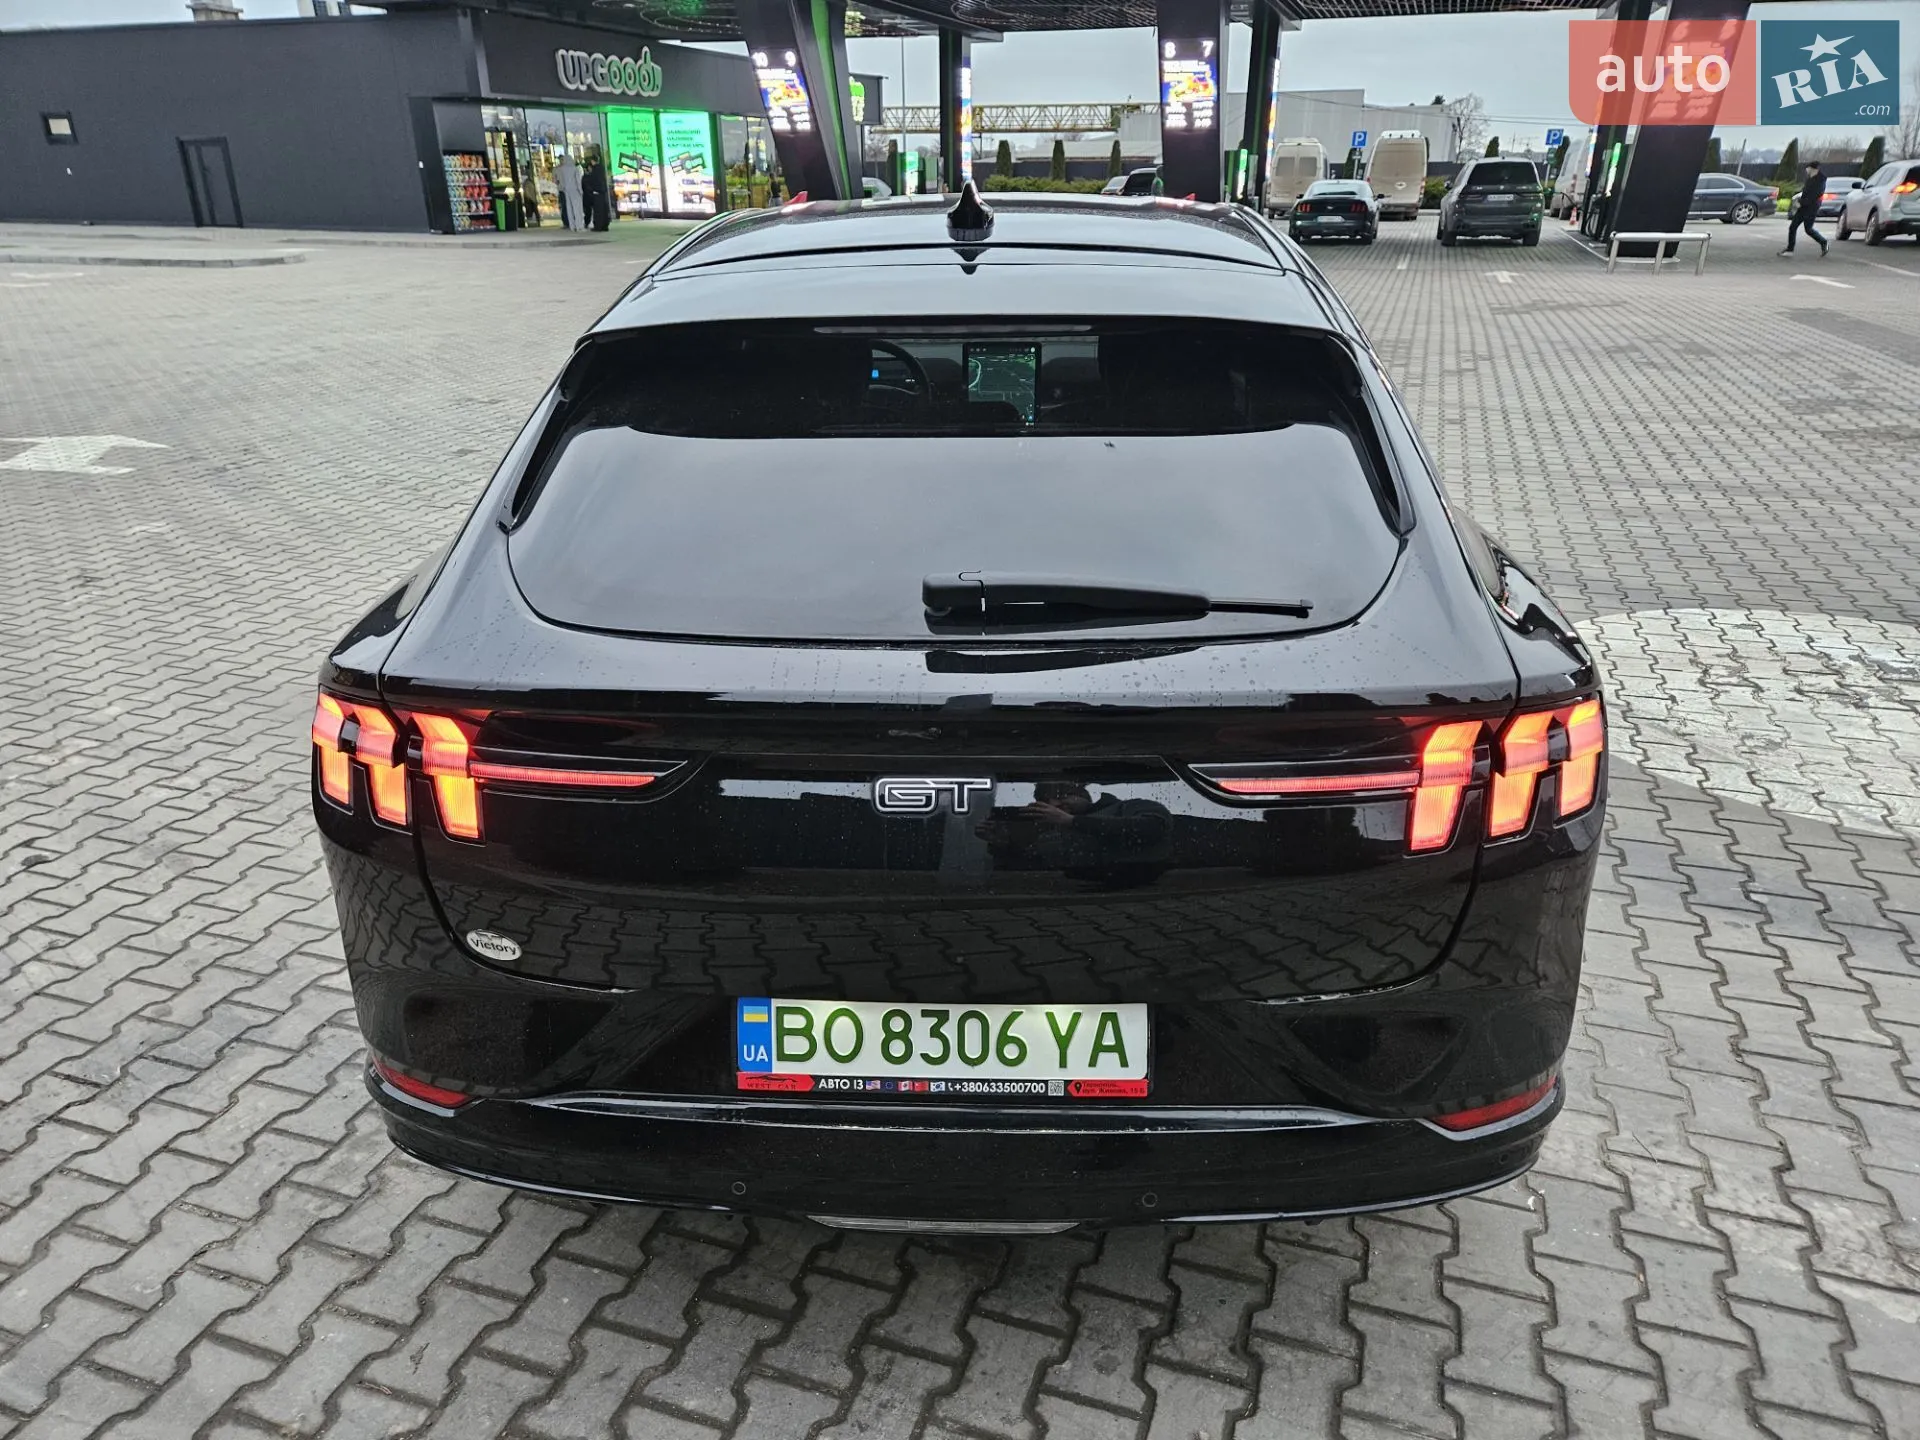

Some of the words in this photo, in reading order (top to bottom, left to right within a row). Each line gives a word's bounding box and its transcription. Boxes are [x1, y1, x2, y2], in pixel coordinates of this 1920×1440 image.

[1164, 41, 1177, 59] 8
[1202, 40, 1214, 58] 7
[785, 51, 797, 68] 9
[875, 777, 991, 813] GT
[470, 938, 517, 956] Victory
[775, 1005, 864, 1064] BO
[880, 1008, 1028, 1067] 8306
[1045, 1011, 1129, 1069] YA
[743, 1044, 769, 1063] UA
[954, 1081, 1046, 1094] +380633500700
